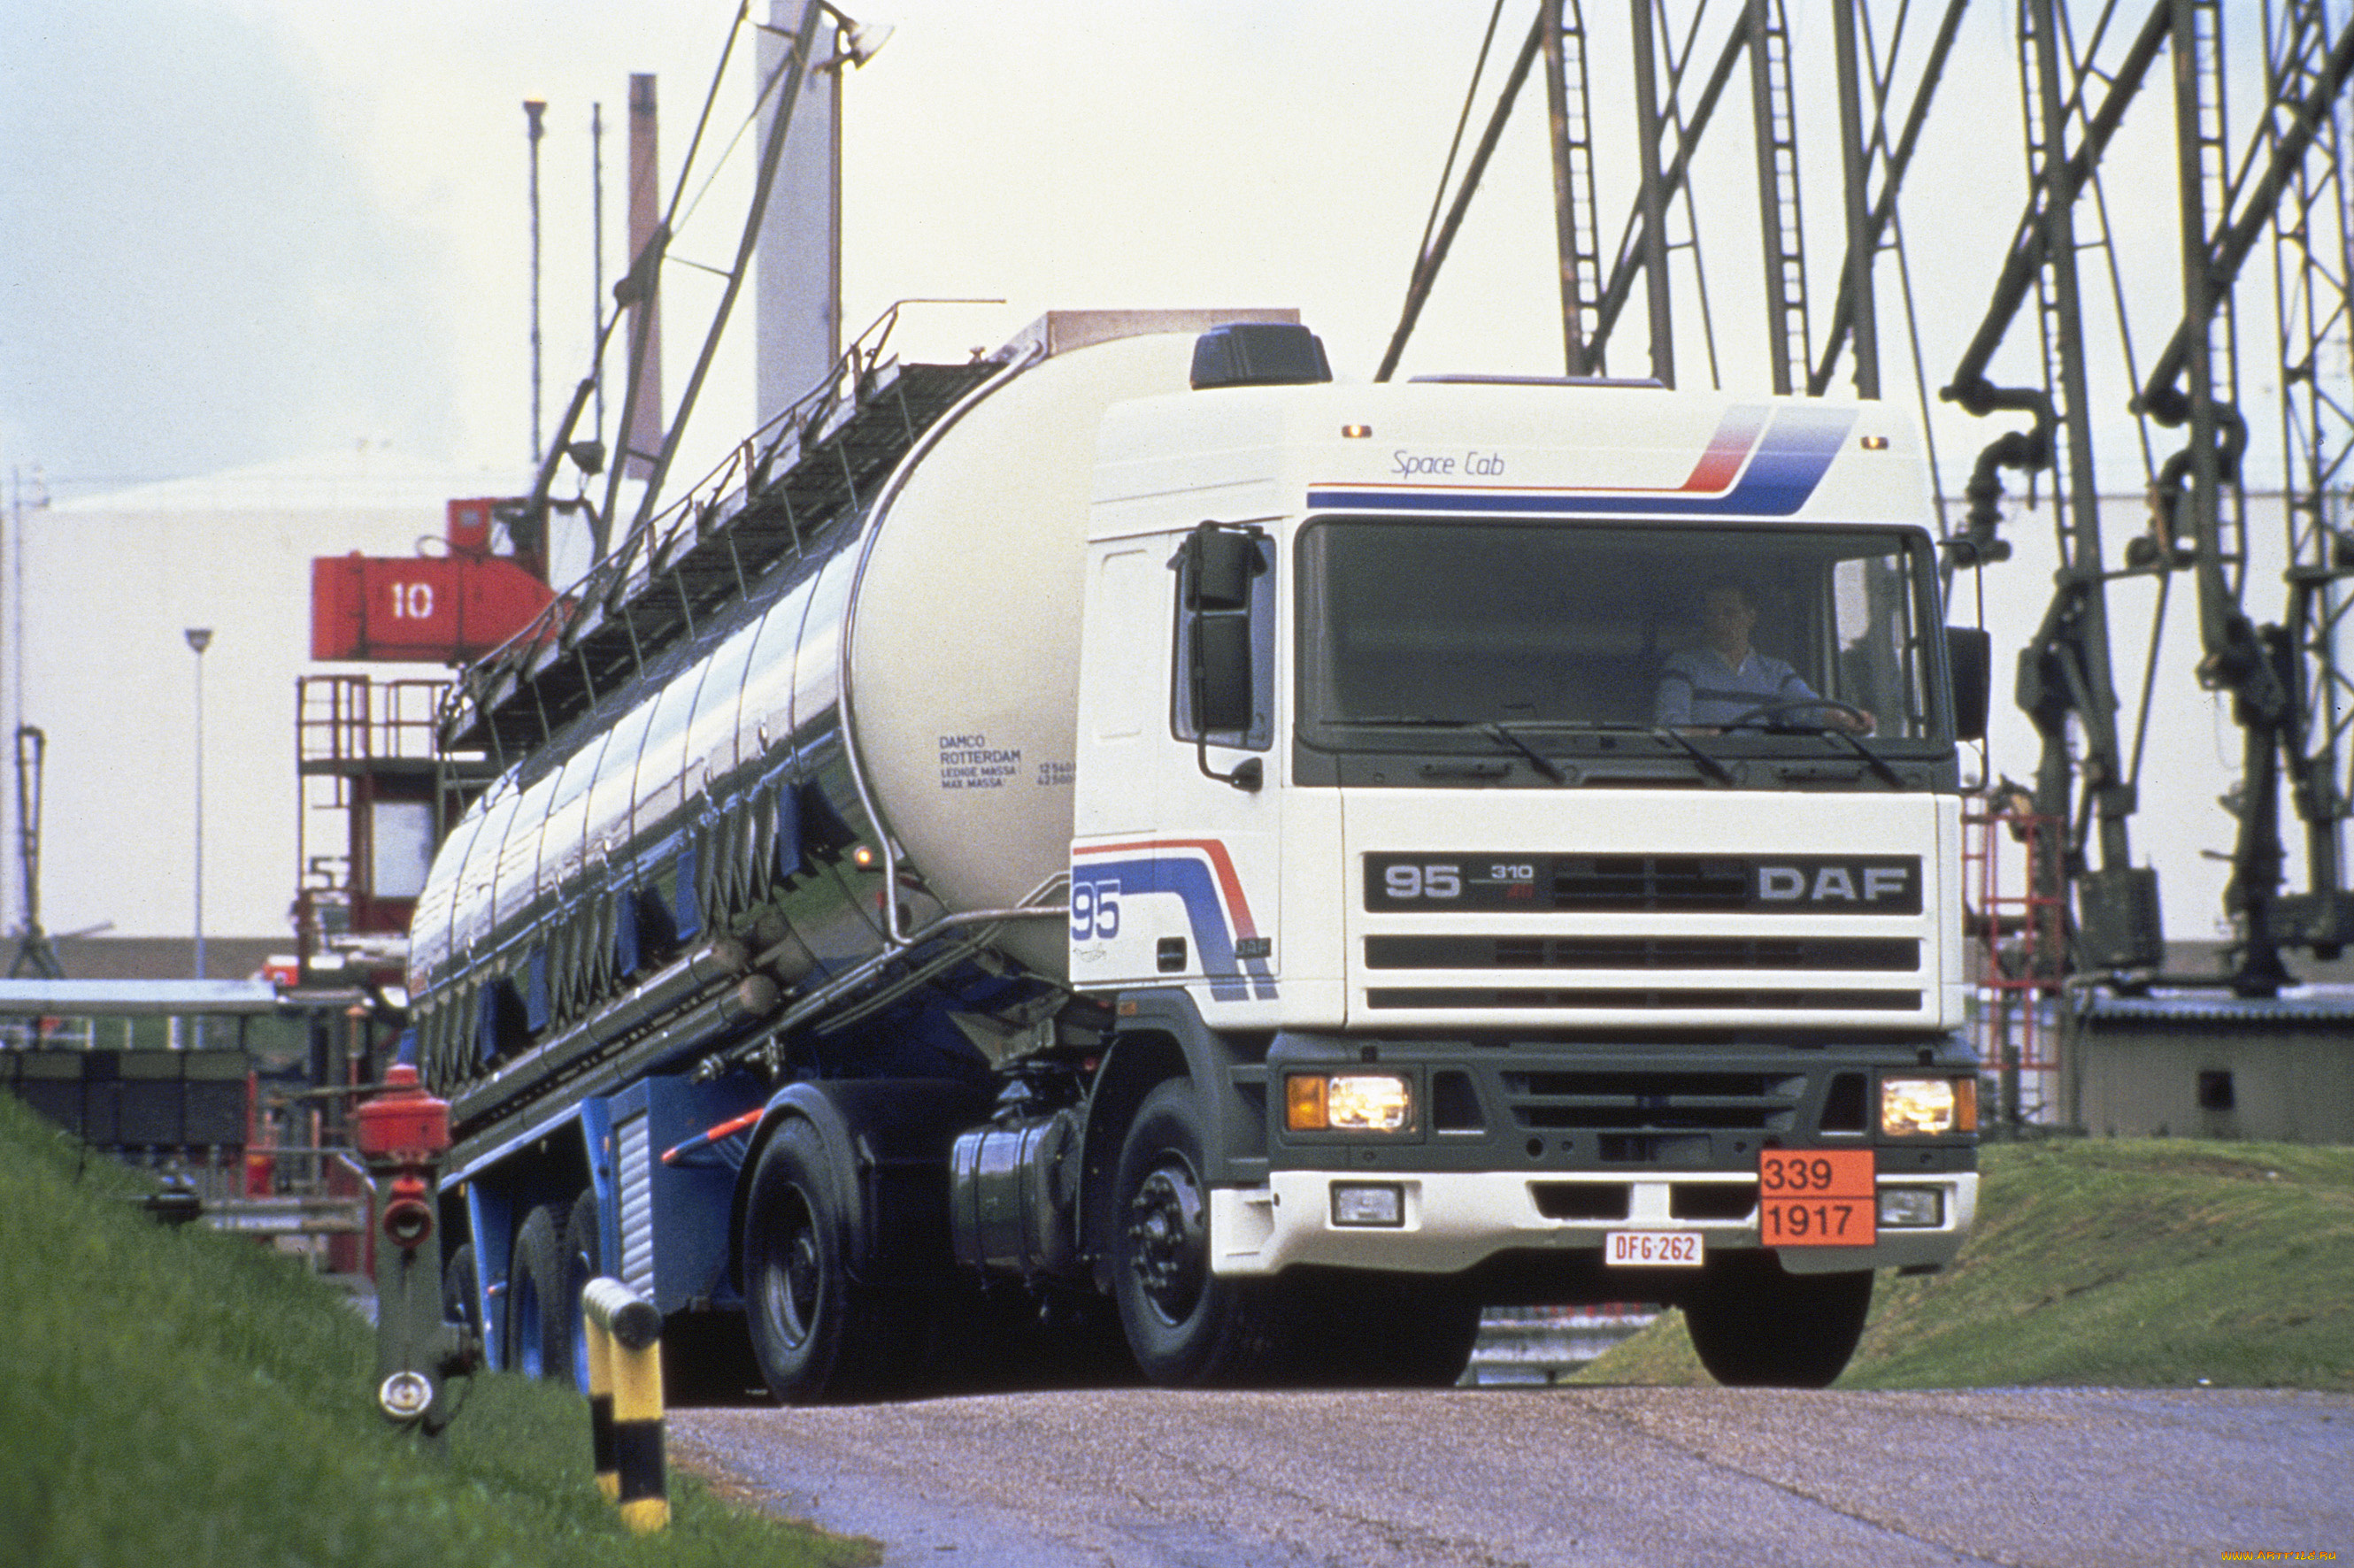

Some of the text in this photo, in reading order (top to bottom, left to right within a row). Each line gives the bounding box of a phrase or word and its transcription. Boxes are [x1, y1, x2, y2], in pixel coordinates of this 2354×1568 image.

[1392, 450, 1504, 480] Space Cab
[392, 582, 434, 619] 10
[939, 734, 985, 749] DAMCO
[940, 750, 1021, 765] ROTTERDAM
[1384, 864, 1908, 900] 95 310 DAF
[1071, 880, 1120, 942] 95
[1764, 1158, 1833, 1190] 339
[1767, 1204, 1853, 1237] 1917
